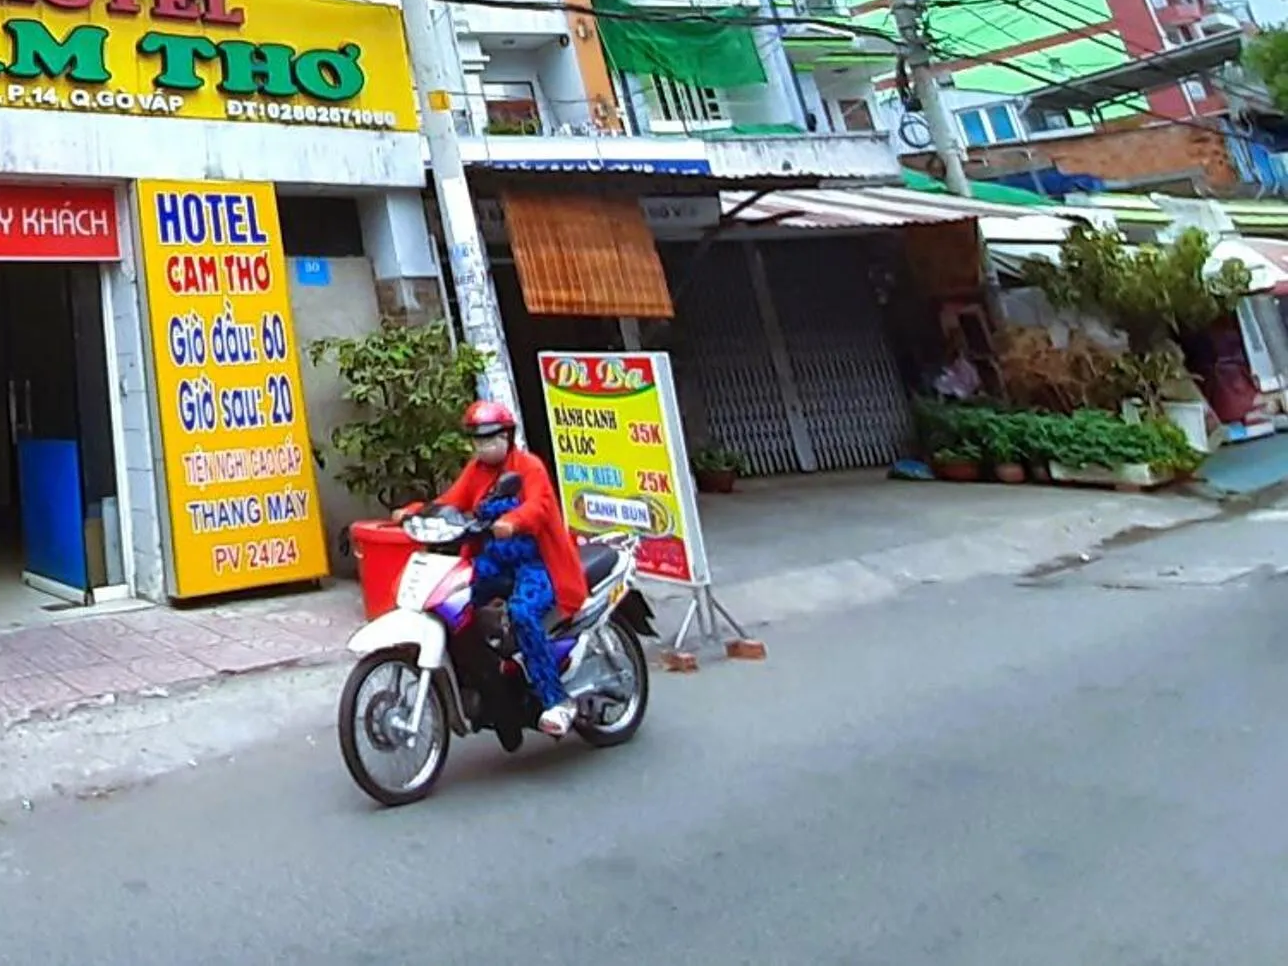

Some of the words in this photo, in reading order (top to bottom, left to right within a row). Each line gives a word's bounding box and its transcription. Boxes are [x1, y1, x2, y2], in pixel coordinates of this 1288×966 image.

[137, 32, 365, 100] THƠ
[138, 89, 184, 113] VẤP
[22, 200, 109, 236] KHÁCH
[157, 192, 267, 243] HOTEL
[167, 255, 219, 293] CAM
[224, 252, 271, 292] THƠ
[170, 314, 205, 365] Giờ
[212, 300, 257, 363] đầu:
[262, 314, 285, 360] 60
[179, 377, 215, 431] Giờ
[221, 388, 264, 428] sau:
[268, 375, 293, 424] 20
[584, 408, 617, 430] CANH
[627, 422, 663, 445] 35K
[250, 448, 275, 476] CAO
[637, 471, 672, 493] 25K
[189, 496, 262, 531] THANG
[267, 486, 308, 523] MÁY
[214, 545, 241, 572] PV
